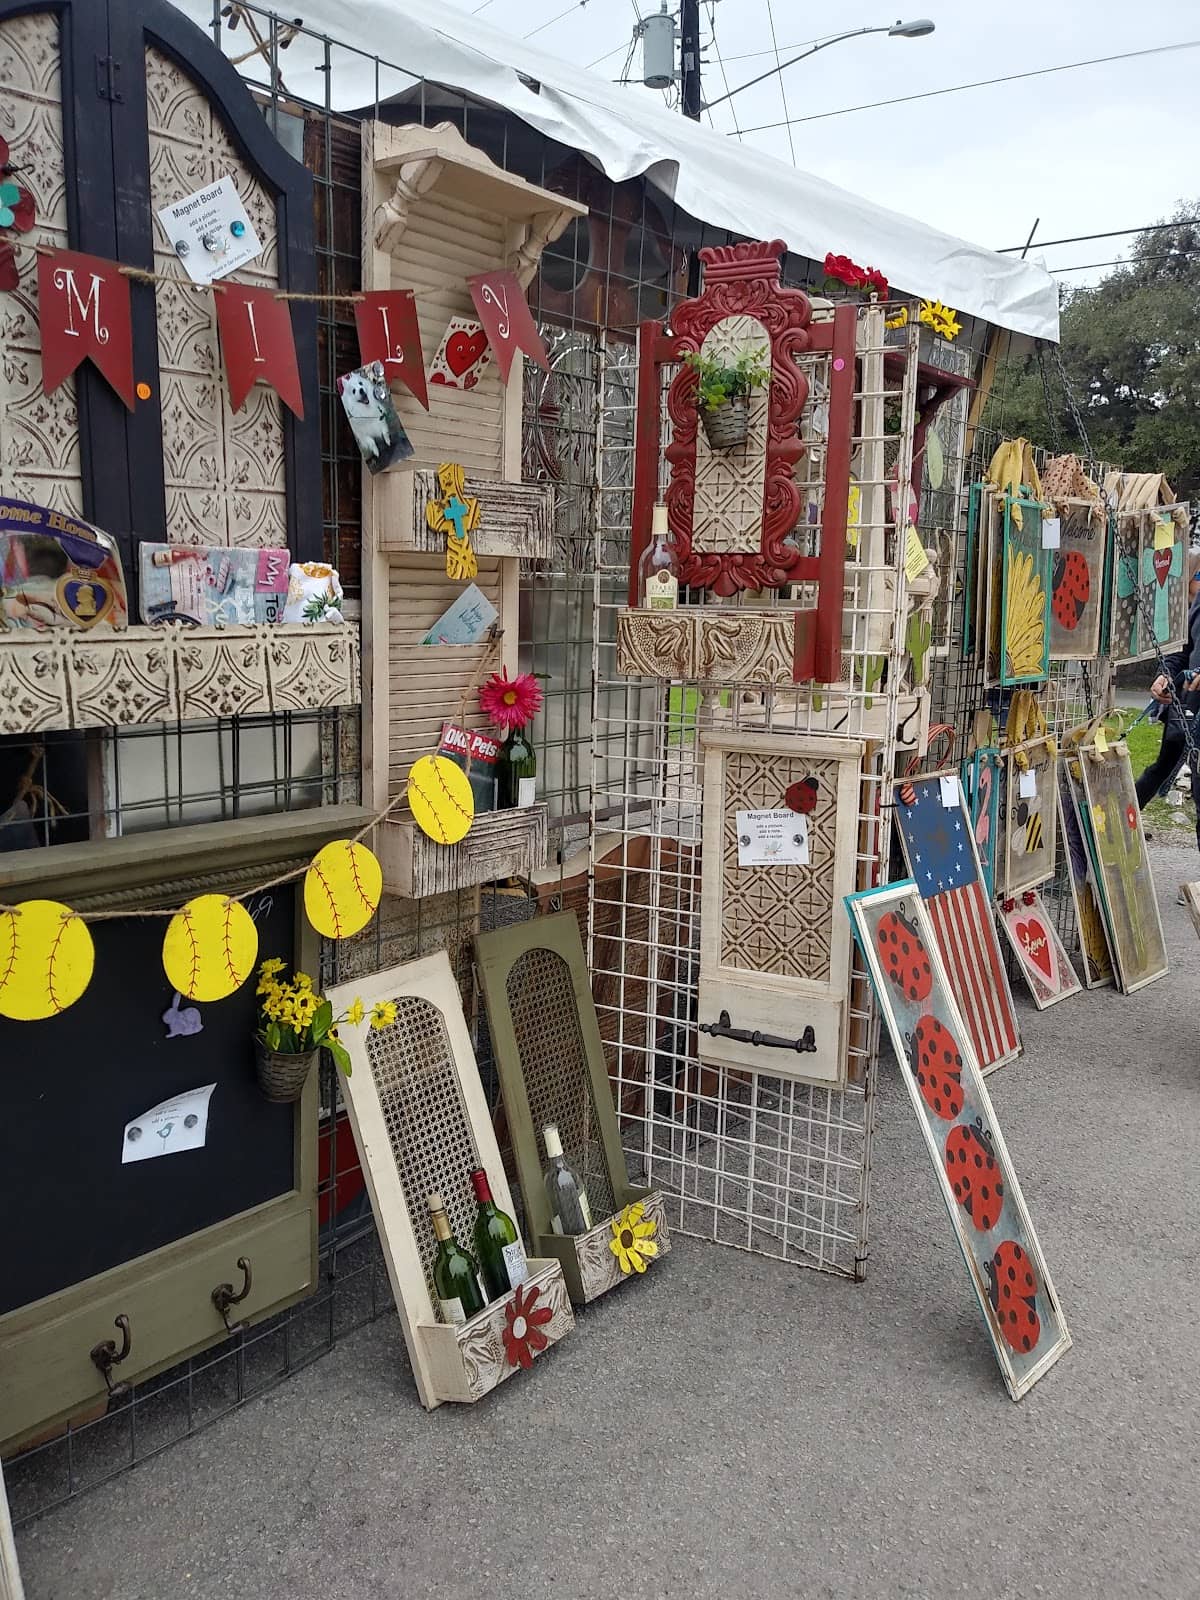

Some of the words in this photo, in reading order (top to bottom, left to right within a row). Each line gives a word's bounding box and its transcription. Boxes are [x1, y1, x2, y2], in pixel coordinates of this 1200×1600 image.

[172, 199, 200, 218] Magnet
[200, 187, 223, 204] Board
[258, 555, 283, 586] My
[471, 736, 498, 757] Pets
